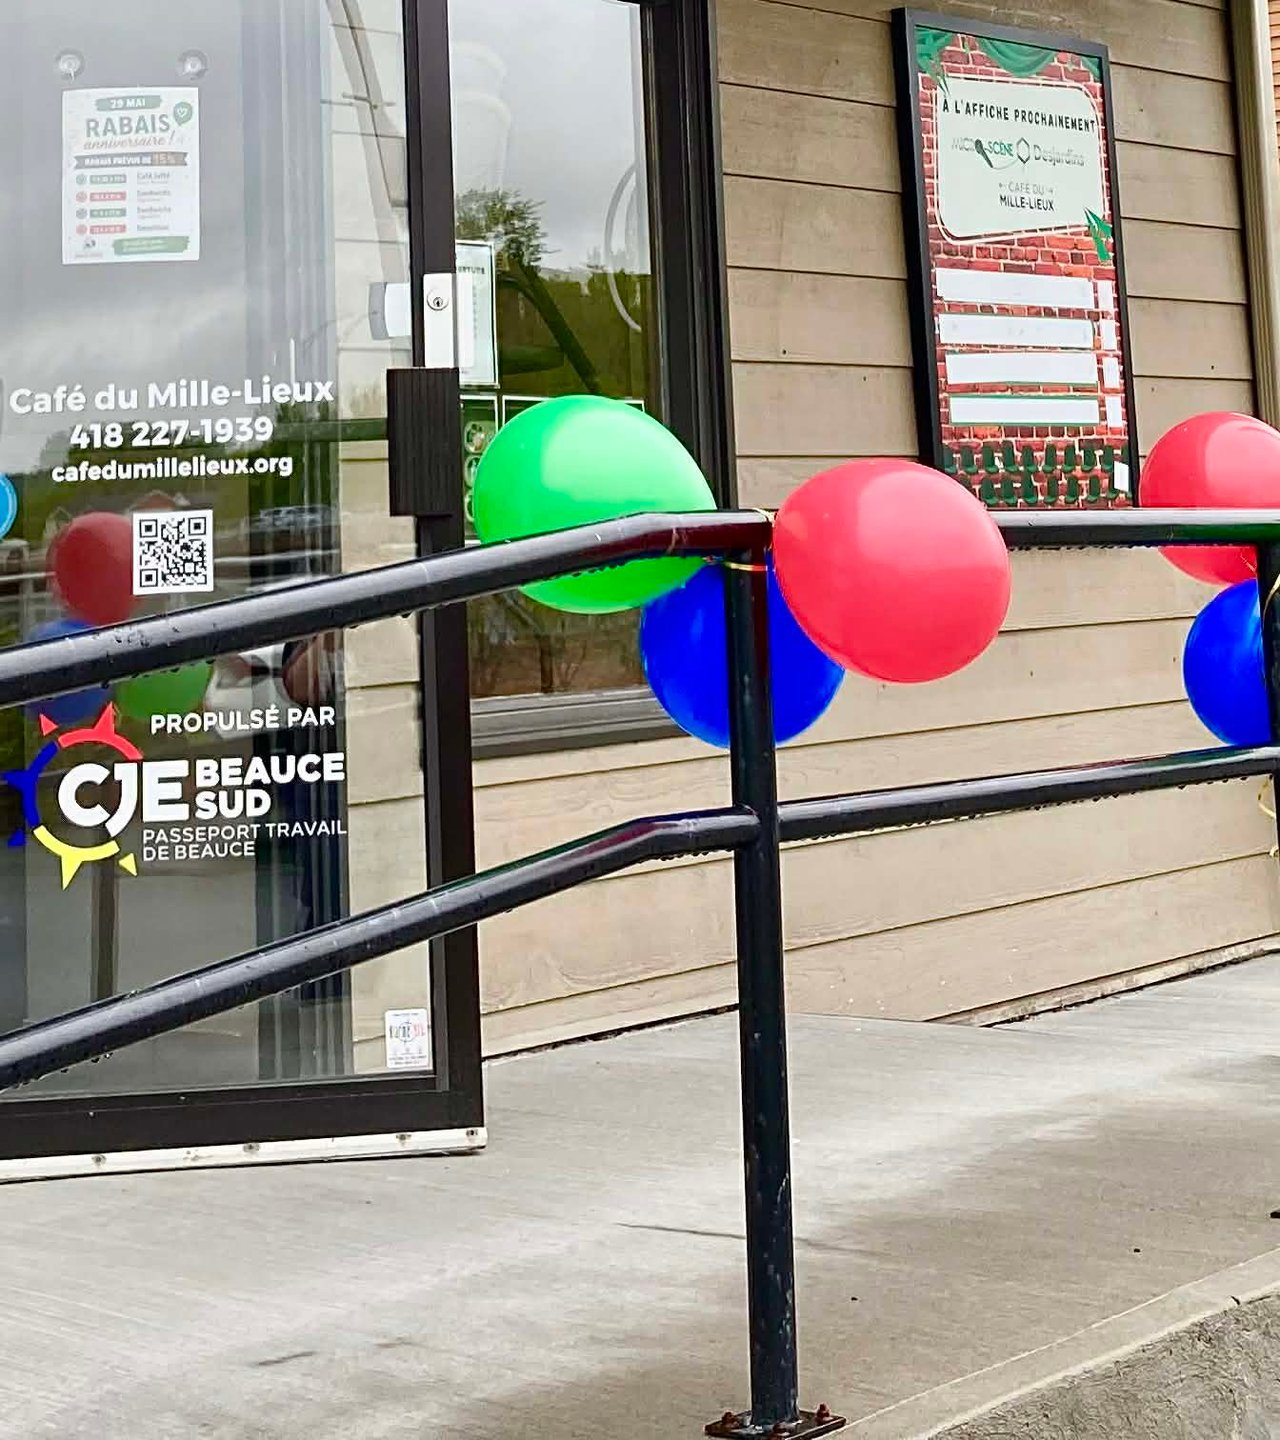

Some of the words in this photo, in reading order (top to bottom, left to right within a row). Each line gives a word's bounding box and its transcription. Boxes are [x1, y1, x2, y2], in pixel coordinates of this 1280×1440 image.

[86, 113, 170, 138] RABAIS
[955, 100, 1010, 121] L'AFFICHE
[1014, 108, 1096, 133] PROCHAINEMENT
[1000, 194, 1054, 212] MILLE-LIEUX
[1032, 184, 1045, 195] DU
[9, 384, 86, 414] Café
[94, 383, 138, 410] du
[147, 375, 335, 409] Mille-Lieux
[70, 423, 124, 449] 418
[131, 416, 274, 447] 227-1939
[51, 456, 294, 483] cafedumillelieux.org
[150, 704, 280, 735] PROPULSÉ
[287, 706, 335, 727] PAR
[195, 752, 345, 789] BEAUCE
[58, 759, 190, 838] CJE
[194, 788, 271, 820] SUD
[143, 824, 261, 844] PASSEPORT
[265, 820, 348, 837] TRAVAIL
[143, 846, 170, 861] DE
[174, 840, 255, 860] BEAUCE
